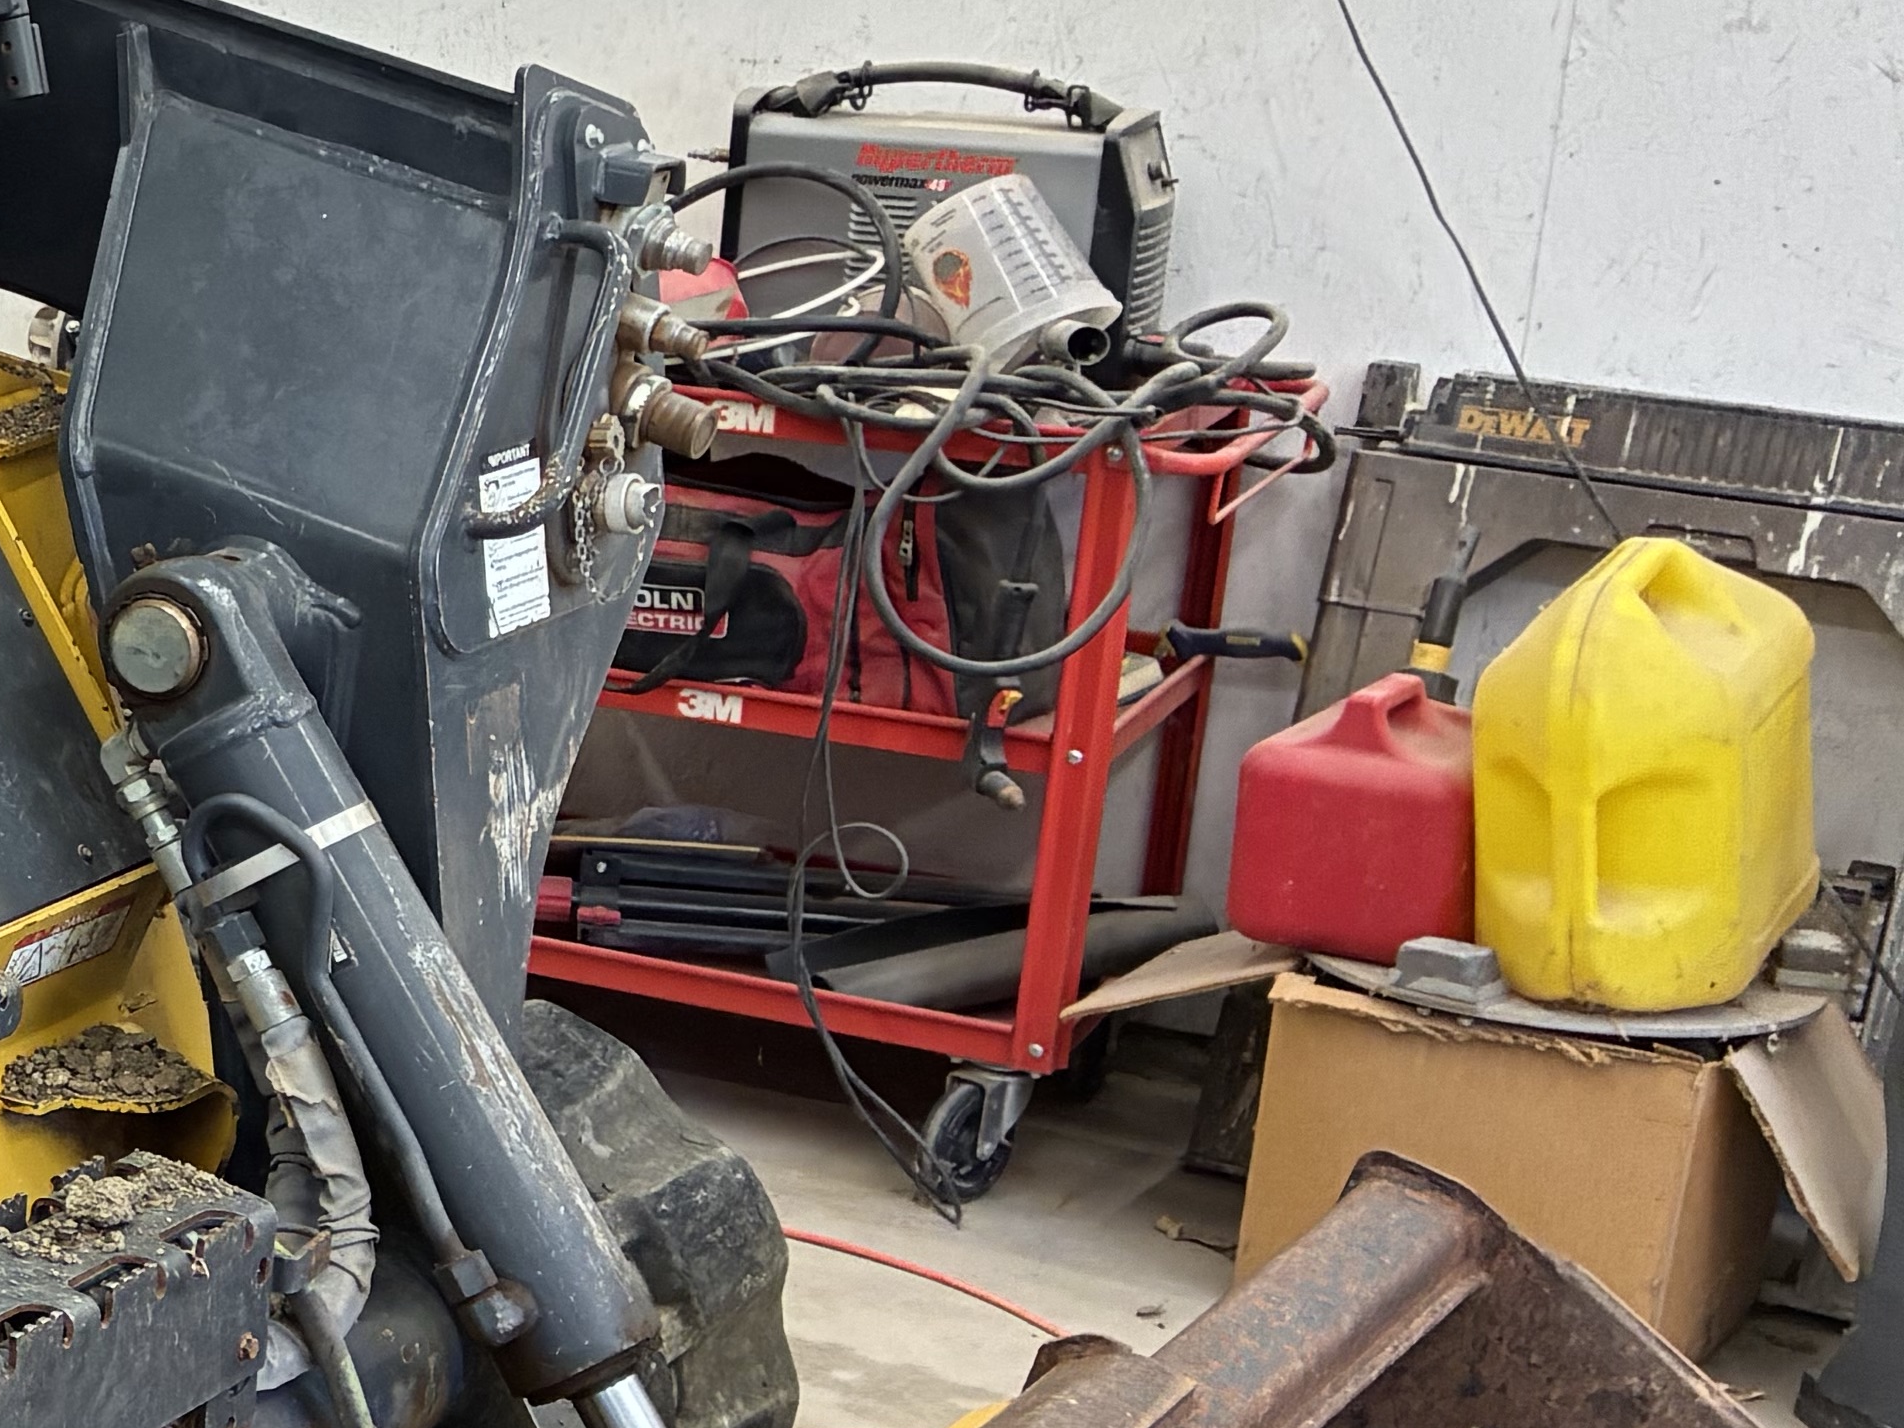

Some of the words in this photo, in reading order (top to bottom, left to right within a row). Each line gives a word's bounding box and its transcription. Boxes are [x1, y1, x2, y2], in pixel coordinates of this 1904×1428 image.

[857, 142, 1016, 176] Hypertherm
[712, 399, 776, 434] 3M
[678, 688, 743, 724] 3M
